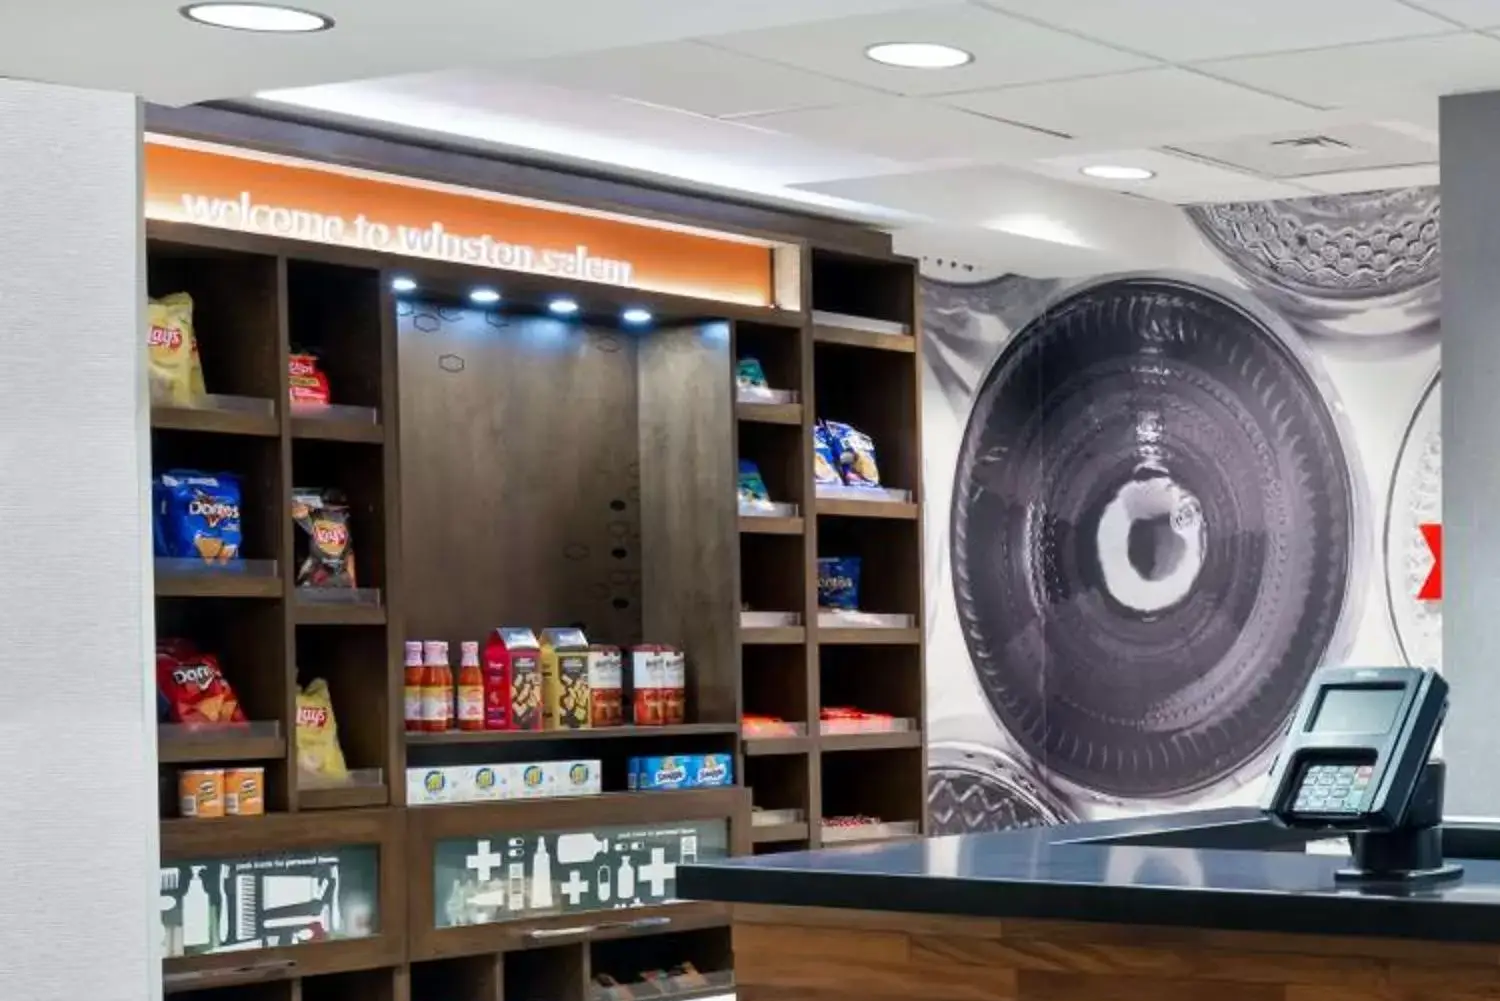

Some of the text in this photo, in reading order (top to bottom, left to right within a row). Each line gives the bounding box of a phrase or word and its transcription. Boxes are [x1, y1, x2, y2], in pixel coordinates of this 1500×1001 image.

[181, 191, 633, 284] welcome to winston salem
